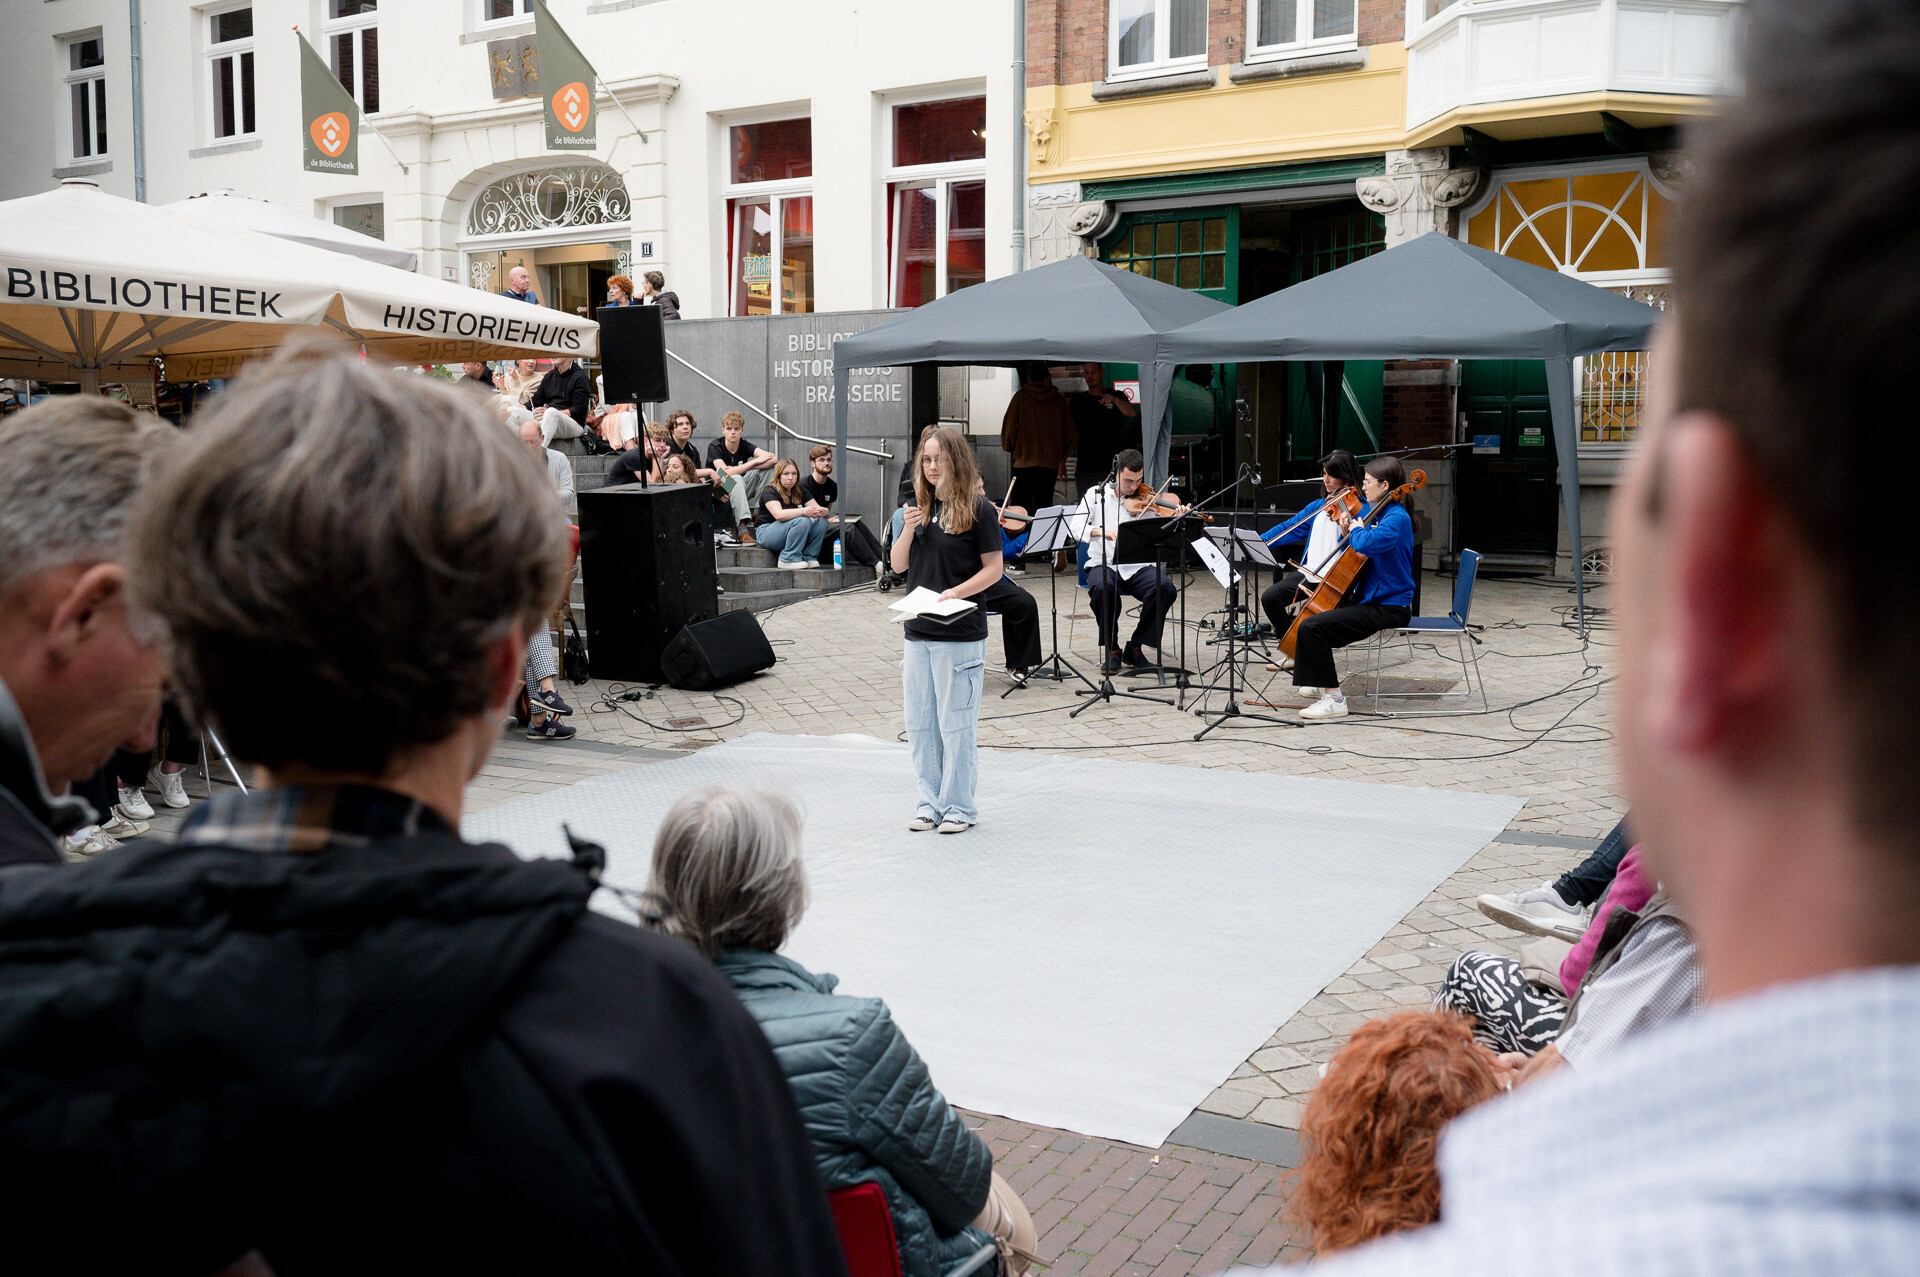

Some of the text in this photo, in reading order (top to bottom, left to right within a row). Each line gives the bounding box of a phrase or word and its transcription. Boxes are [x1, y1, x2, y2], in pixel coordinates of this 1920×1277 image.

[554, 136, 562, 144] de
[310, 158, 354, 170] de Bibliotheek
[7, 267, 284, 319] BIBLIOTHEEK
[383, 304, 581, 350] HISTORIEHUIS
